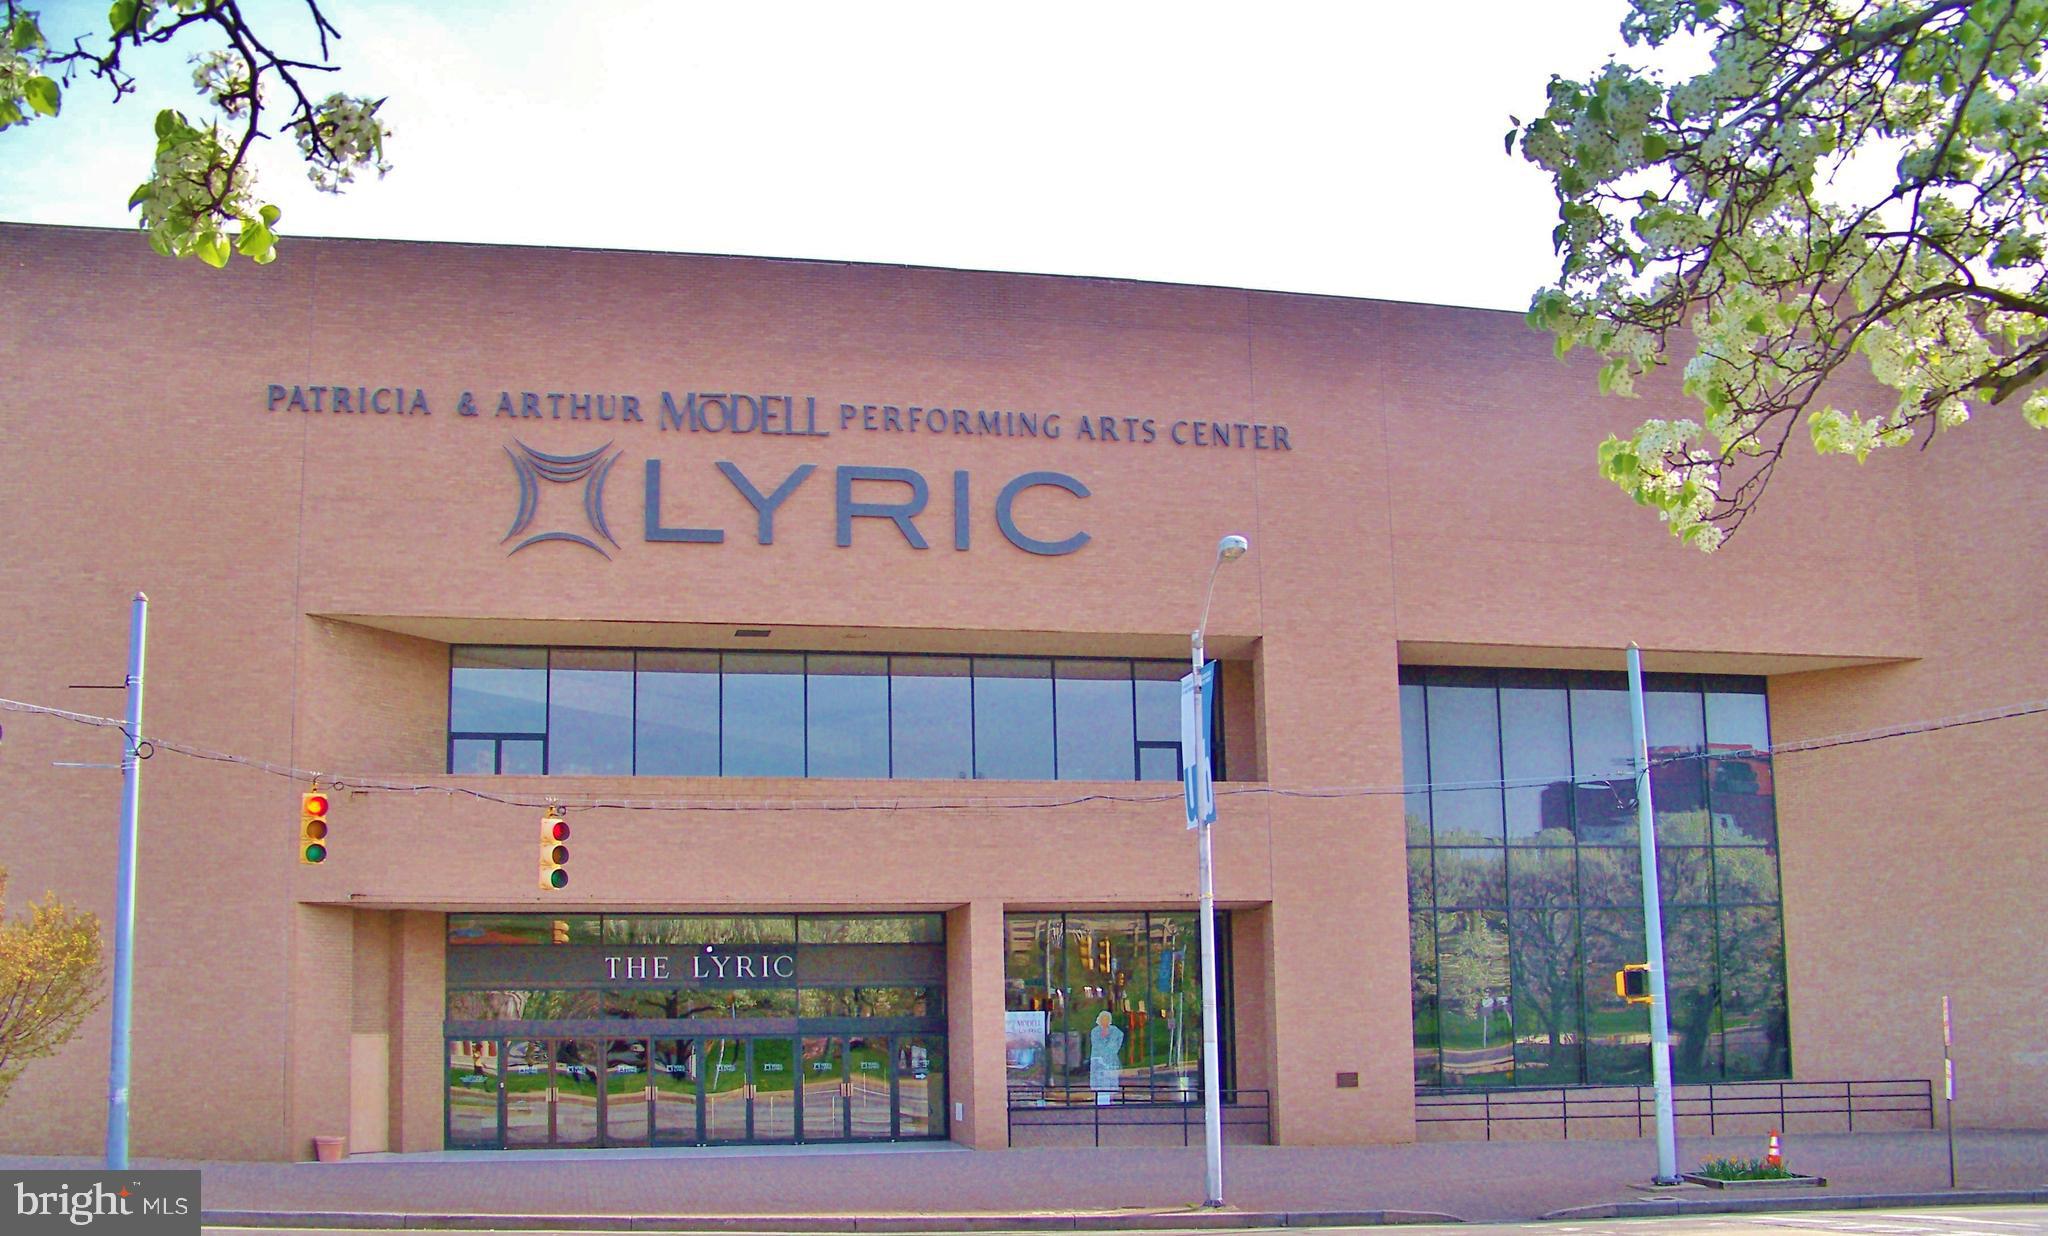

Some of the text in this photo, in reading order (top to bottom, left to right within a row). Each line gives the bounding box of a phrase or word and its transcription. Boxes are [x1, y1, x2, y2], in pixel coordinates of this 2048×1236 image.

[267, 384, 431, 415] PATRICIA
[457, 391, 478, 417] &
[495, 391, 643, 422] ARTHUR
[840, 403, 1061, 439] PERFORMING
[1077, 415, 1158, 443] ARTS
[1171, 420, 1293, 451] CENTER
[645, 459, 1092, 556] LYRIC
[605, 955, 794, 979] THE LYRIC
